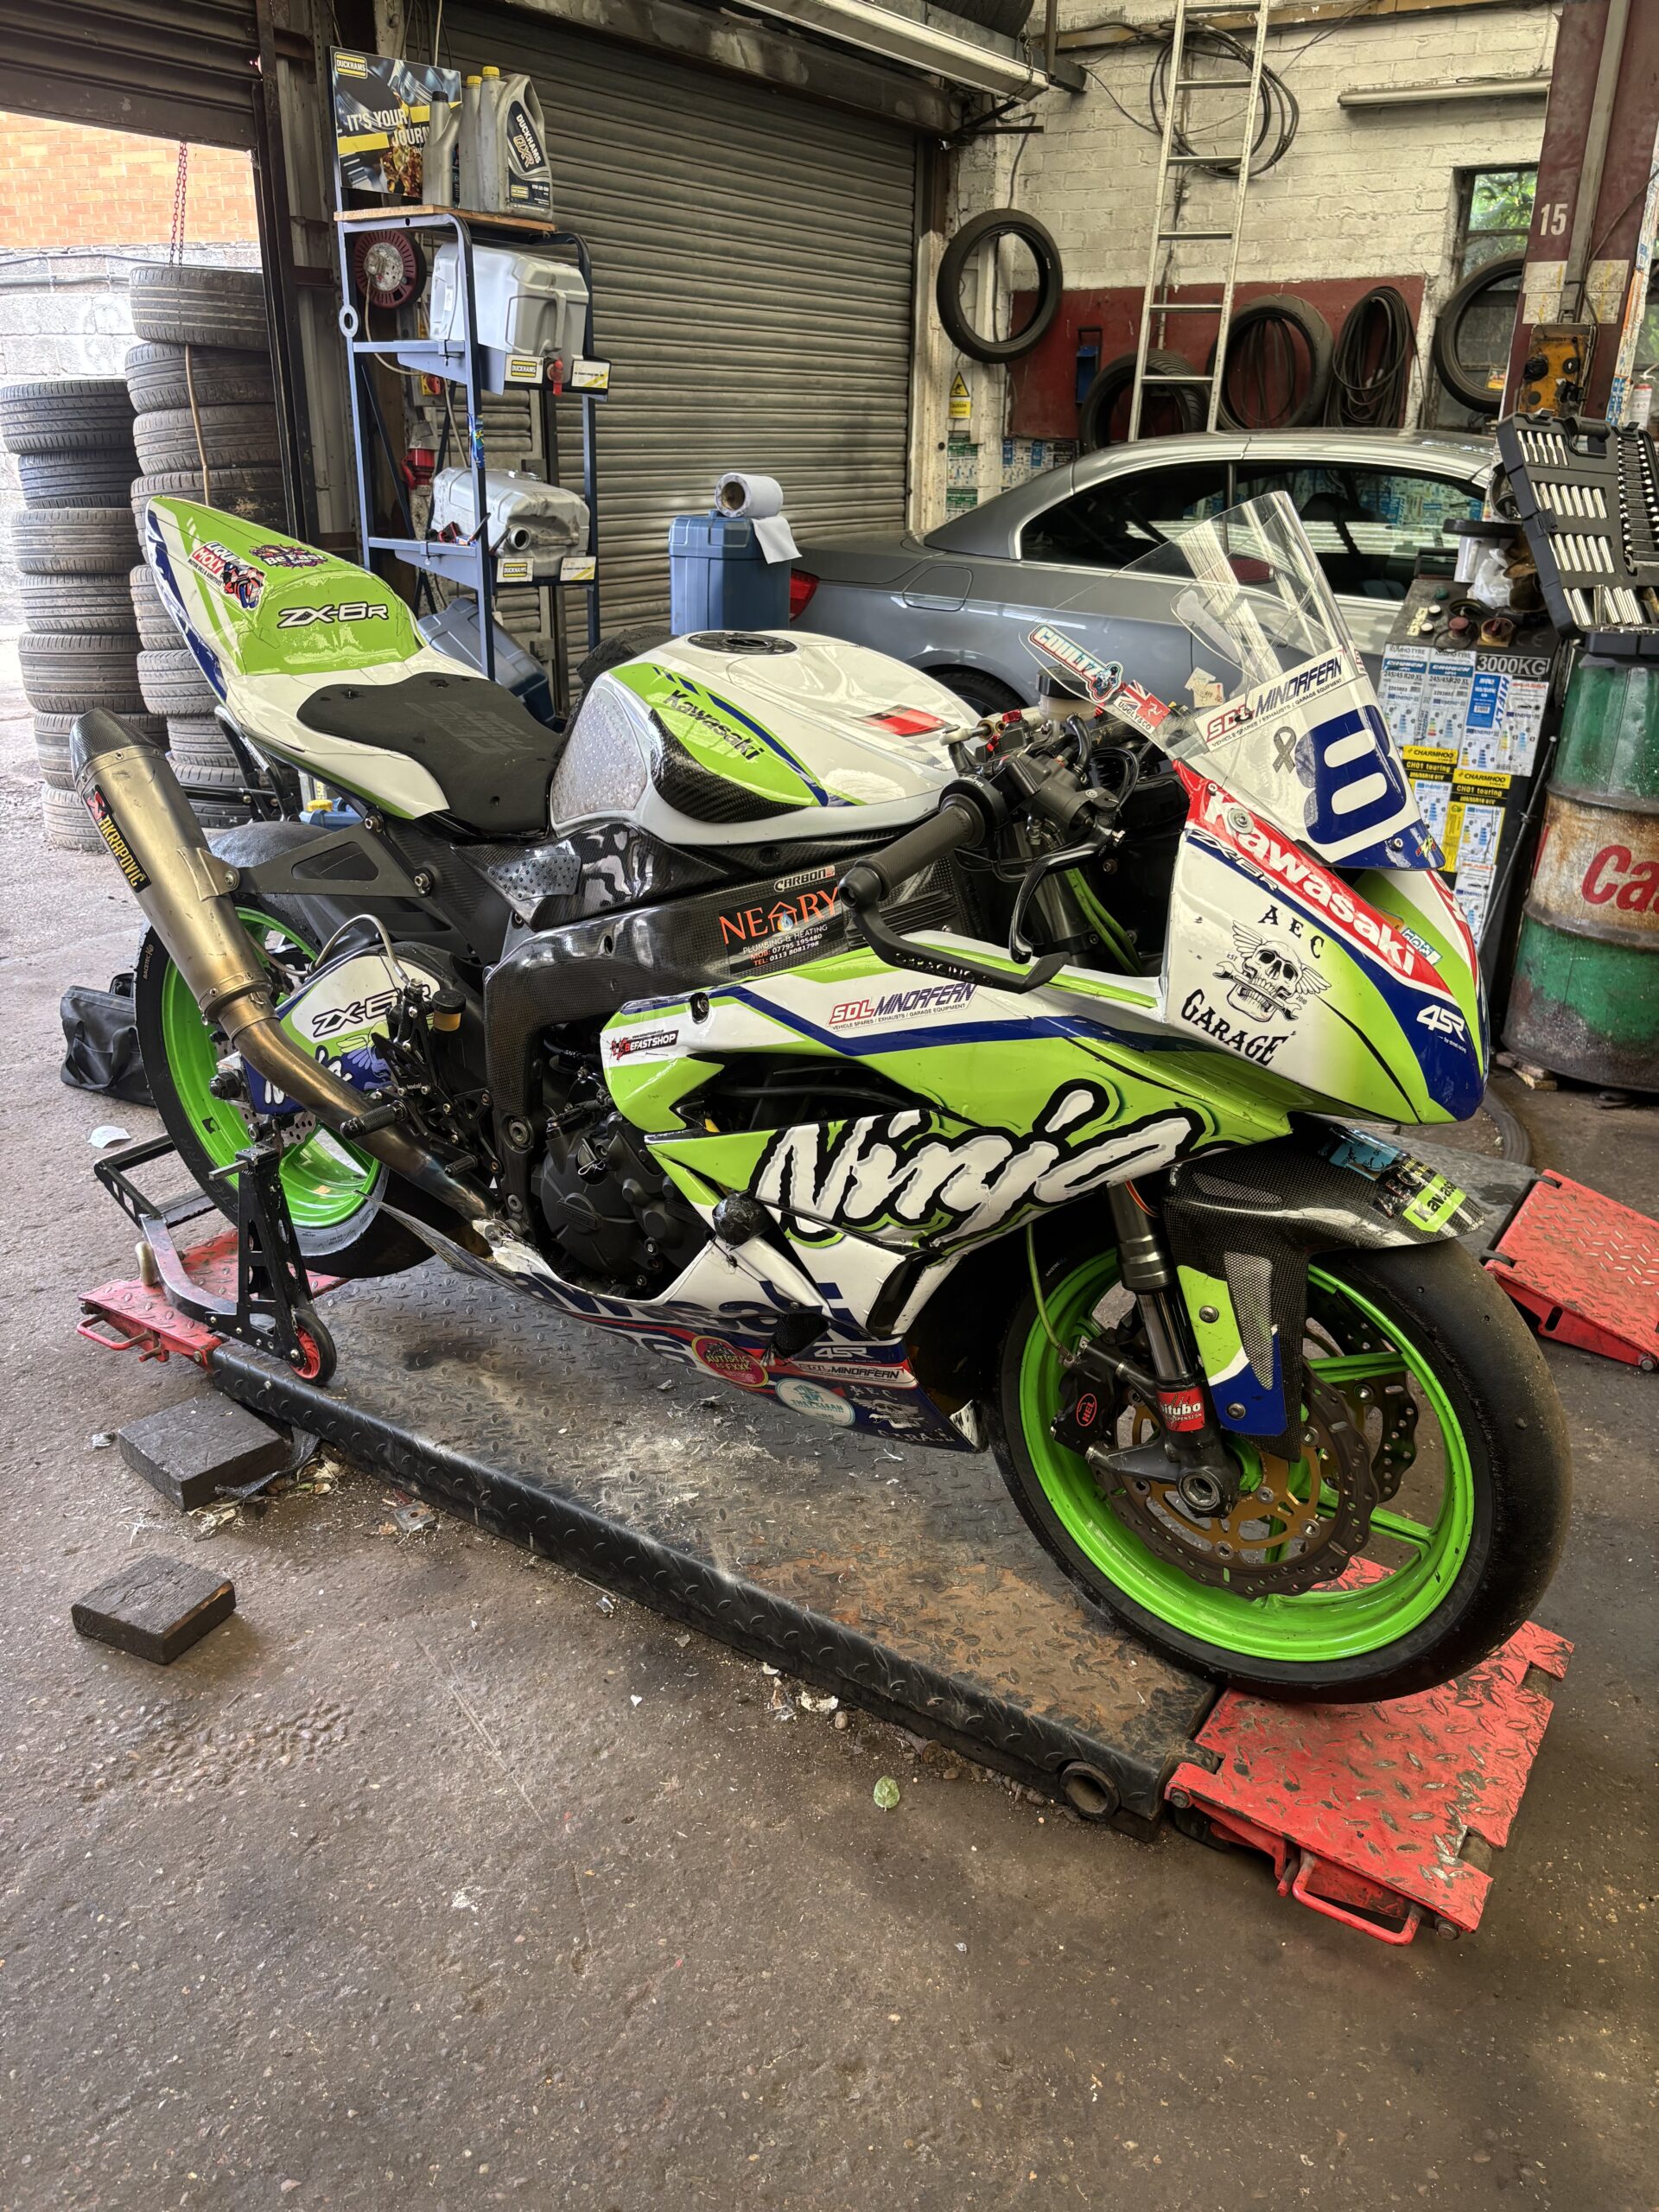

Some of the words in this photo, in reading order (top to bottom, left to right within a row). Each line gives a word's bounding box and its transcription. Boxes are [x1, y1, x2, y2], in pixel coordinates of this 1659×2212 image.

[336, 59, 366, 72] DUCKHAMS
[346, 112, 372, 132] IT'S
[373, 108, 408, 127] YOUR
[516, 114, 542, 164] DUCKHAMS
[1540, 202, 1568, 236] 15
[512, 364, 537, 373] DUCKHAMS
[193, 548, 226, 574] MOLY
[277, 602, 389, 629] ZX-6R
[1033, 626, 1103, 681] COULTZ
[1477, 655, 1547, 675] 3000KG
[1255, 657, 1342, 718] MINORFERN
[664, 690, 765, 760] Kawasaki
[1211, 732, 1236, 747] VEHICLE
[1236, 720, 1259, 735] SPARES
[1262, 703, 1292, 722] EXHAUSTS
[1295, 690, 1317, 705] GARAGE
[1317, 677, 1342, 694] EQUIPMENT
[1407, 760, 1424, 770] CH01
[1426, 763, 1451, 772] touring
[1414, 749, 1454, 759] CHARMHOO
[1295, 704, 1407, 845] 8
[1464, 772, 1506, 783] CHARMHOO
[1456, 785, 1474, 793] CH01
[1476, 787, 1503, 797] touring
[774, 869, 827, 893] CARBON
[1204, 791, 1415, 976] Kawasaki
[1581, 844, 1659, 915] Ca
[742, 937, 784, 954] PLUMBING
[794, 924, 828, 941] HEATING
[750, 950, 771, 961] MOB:
[772, 942, 795, 954] 07795
[797, 933, 823, 947] 195480
[769, 951, 787, 962] 0113
[829, 999, 876, 1025] SDL
[873, 982, 977, 1017] MINORFERN
[832, 1022, 853, 1031] VEHICLE
[854, 1018, 874, 1027] SPARES
[878, 1013, 906, 1023] EXHAUSTS
[909, 1008, 932, 1018] GARAGE
[932, 1002, 966, 1014] EQUIPMENT
[1180, 988, 1290, 1067] GARAGE
[1416, 1004, 1465, 1042] 4SR
[625, 1033, 677, 1052] BEFASTSHOP
[755, 1089, 1192, 1249] Ninja
[705, 1354, 750, 1363] AUTISTIC
[813, 1347, 874, 1359] 4SR
[830, 1366, 899, 1380] MINORFERN
[1082, 1400, 1096, 1423] HEL
